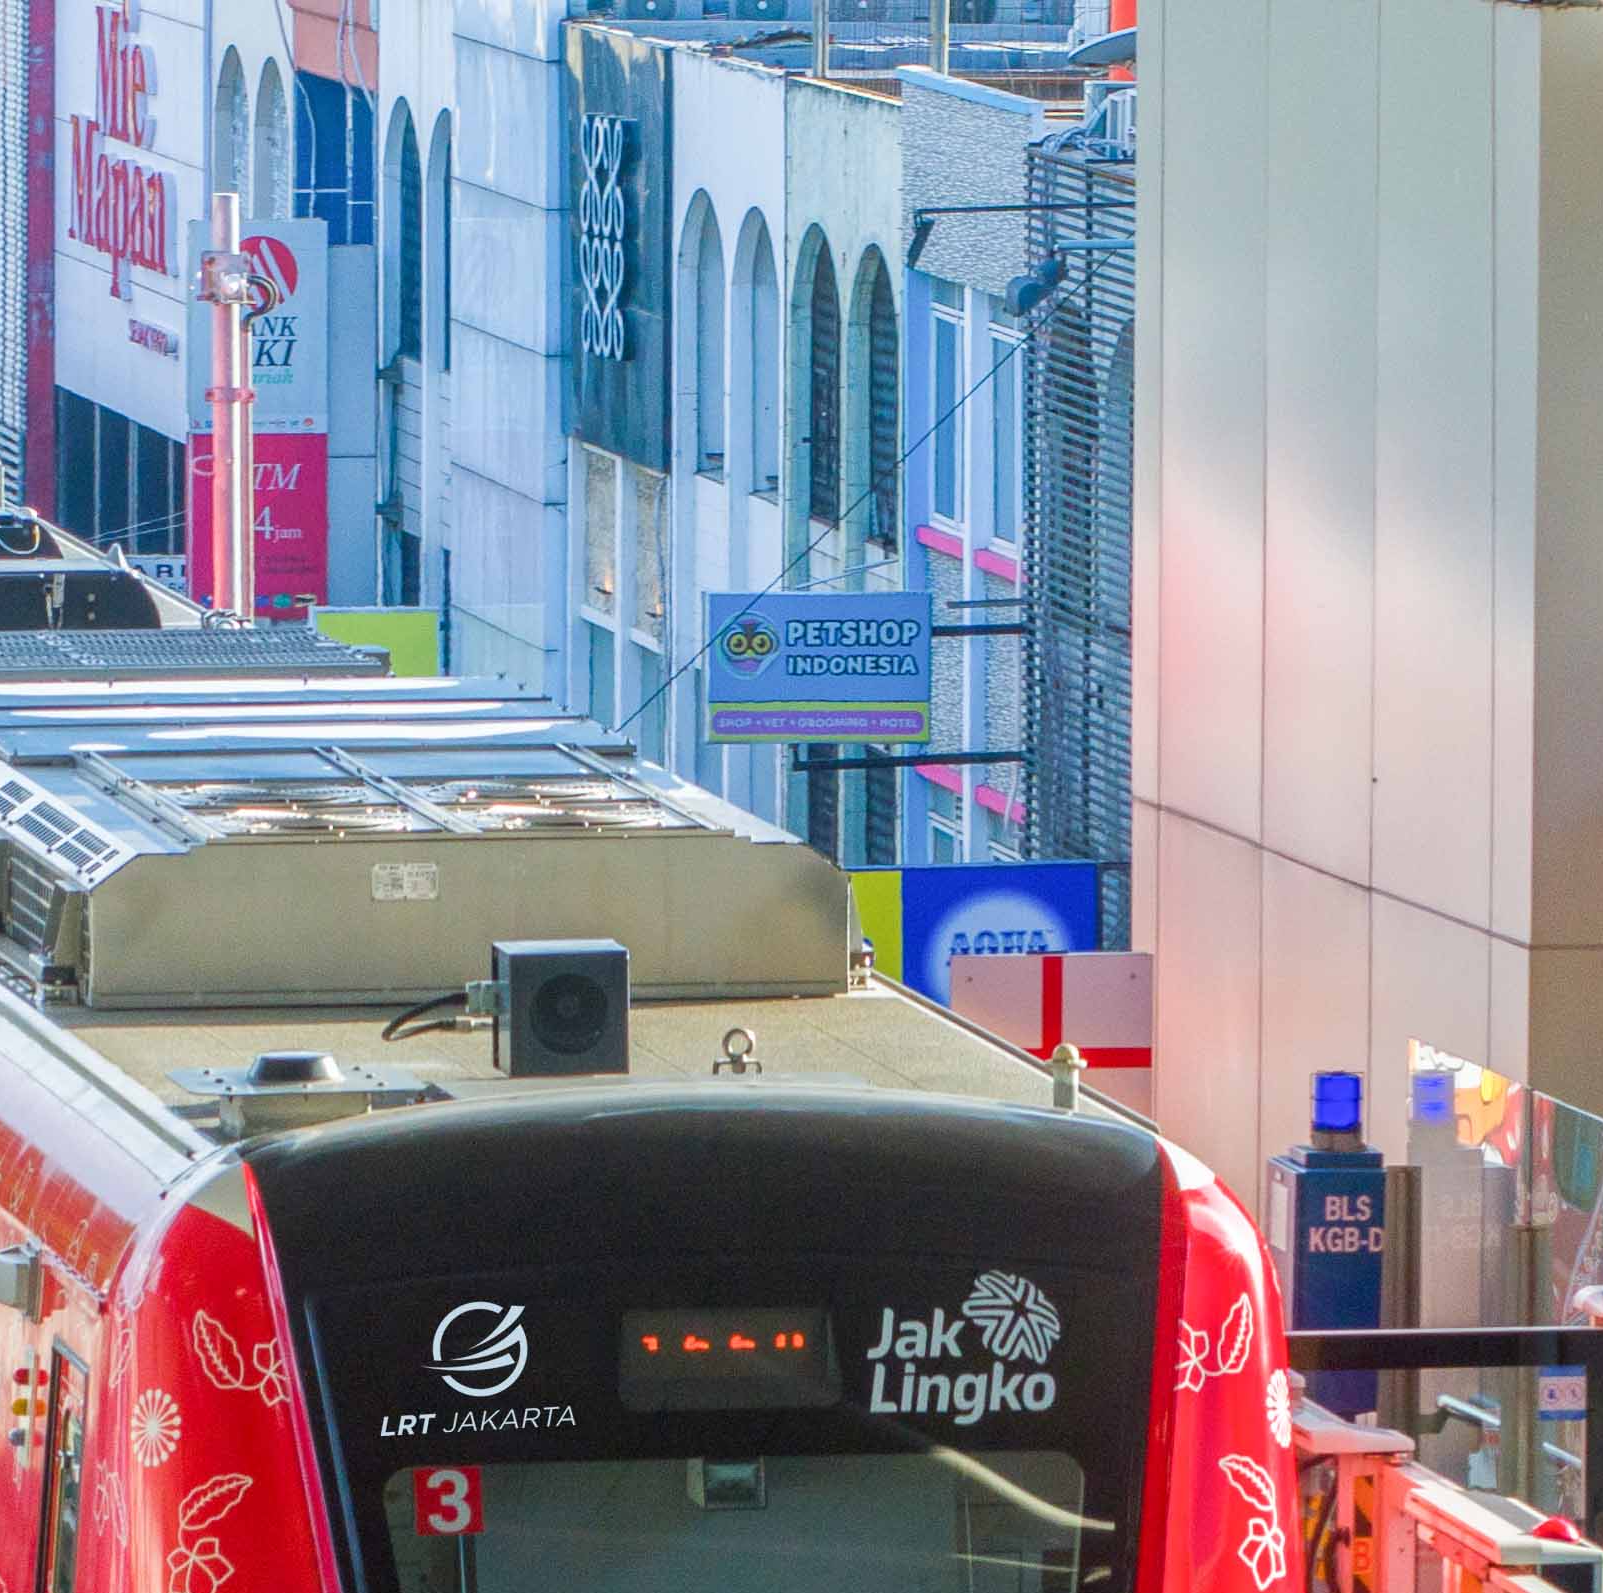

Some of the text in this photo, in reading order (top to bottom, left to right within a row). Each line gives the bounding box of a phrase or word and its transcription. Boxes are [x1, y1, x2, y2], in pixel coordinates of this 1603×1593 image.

[96, 0, 147, 147] Mie
[68, 114, 167, 298] Mapan
[253, 339, 298, 367] KI
[254, 464, 301, 490] TM
[273, 530, 302, 543] jam
[786, 619, 920, 648] PETSHOP
[786, 654, 919, 676] INDONESIA
[1324, 1196, 1372, 1221] BLS
[866, 1307, 966, 1360] Jak
[869, 1361, 1057, 1425] Lingko
[380, 1405, 577, 1437] LRT JAKARTA
[426, 1469, 472, 1534] 3
[1353, 1541, 1373, 1573] B
